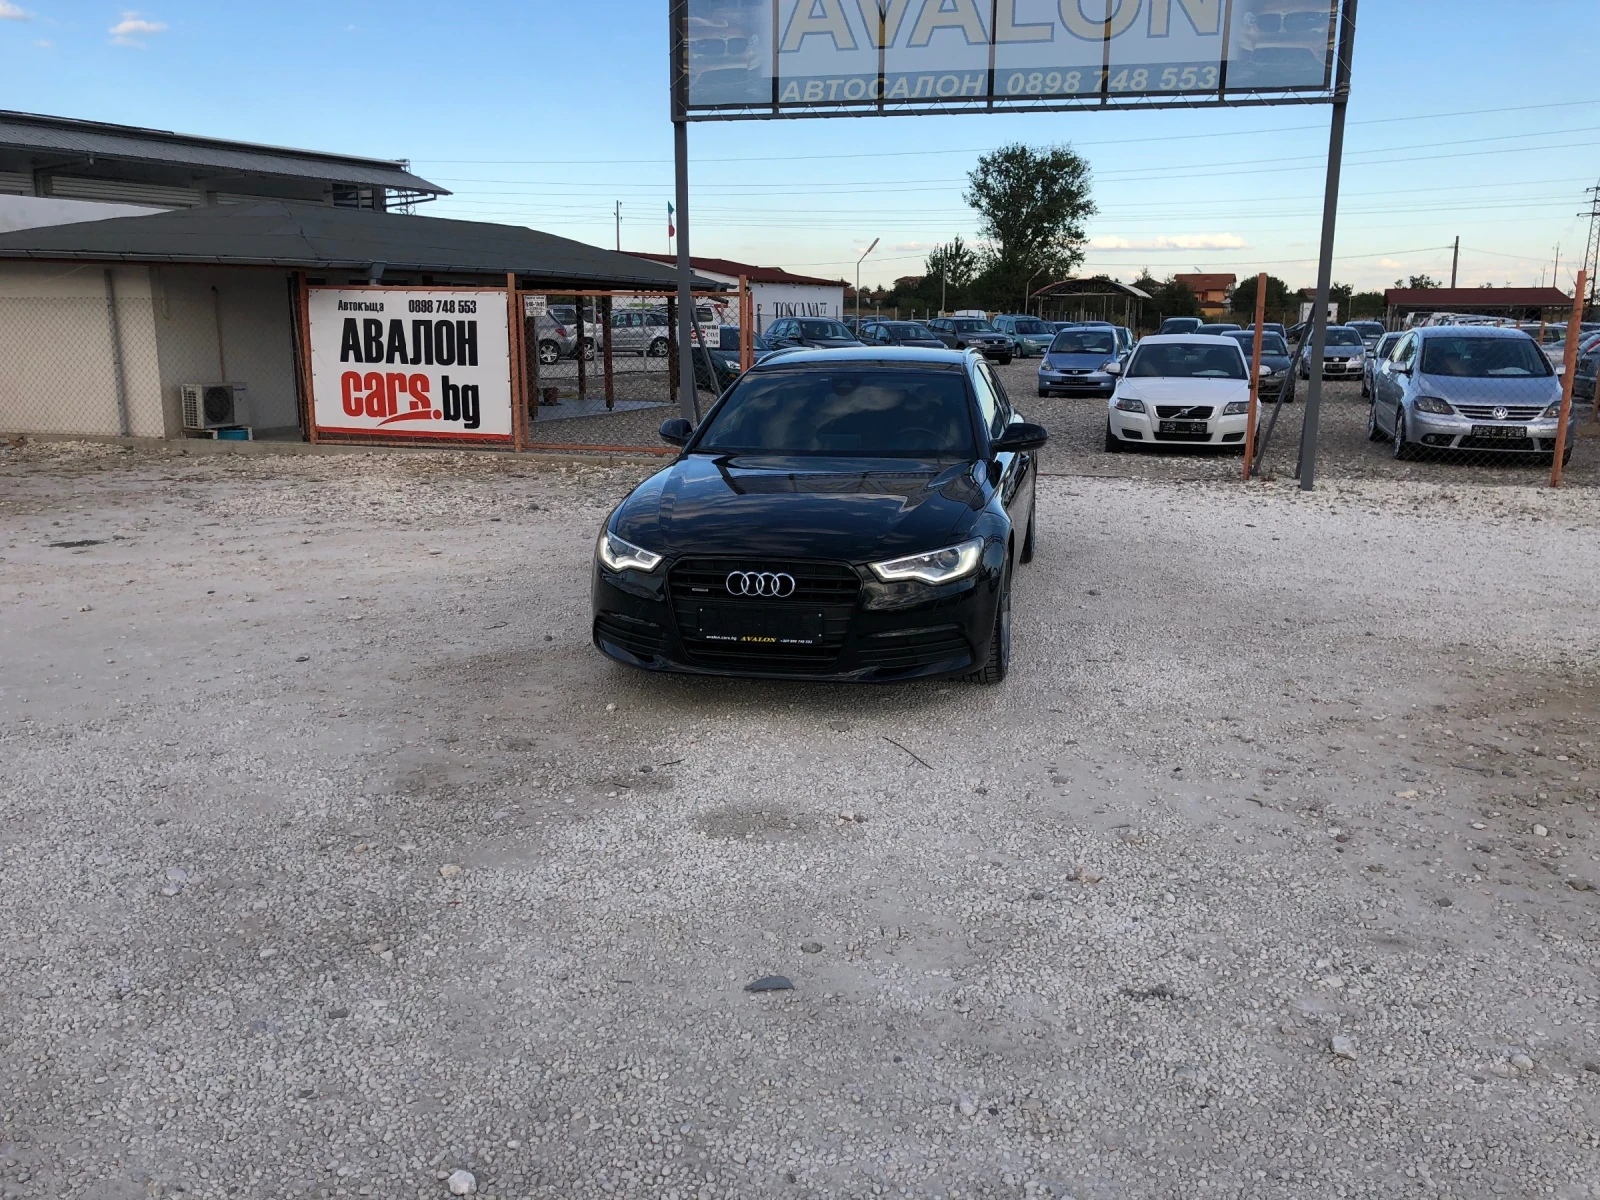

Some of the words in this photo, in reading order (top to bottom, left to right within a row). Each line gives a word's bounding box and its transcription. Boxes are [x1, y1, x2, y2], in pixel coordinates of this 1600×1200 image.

[780, 74, 986, 103] АВТОСАЛОН
[1007, 71, 1081, 95] 0898
[1092, 69, 1148, 92] 748
[1159, 67, 1218, 90] 553
[337, 299, 385, 312] Автокъща
[408, 300, 433, 313] 0898
[435, 300, 456, 313] 748
[458, 300, 477, 314] 553
[340, 317, 479, 366] АВАЛОН
[341, 371, 480, 429] cars.bg
